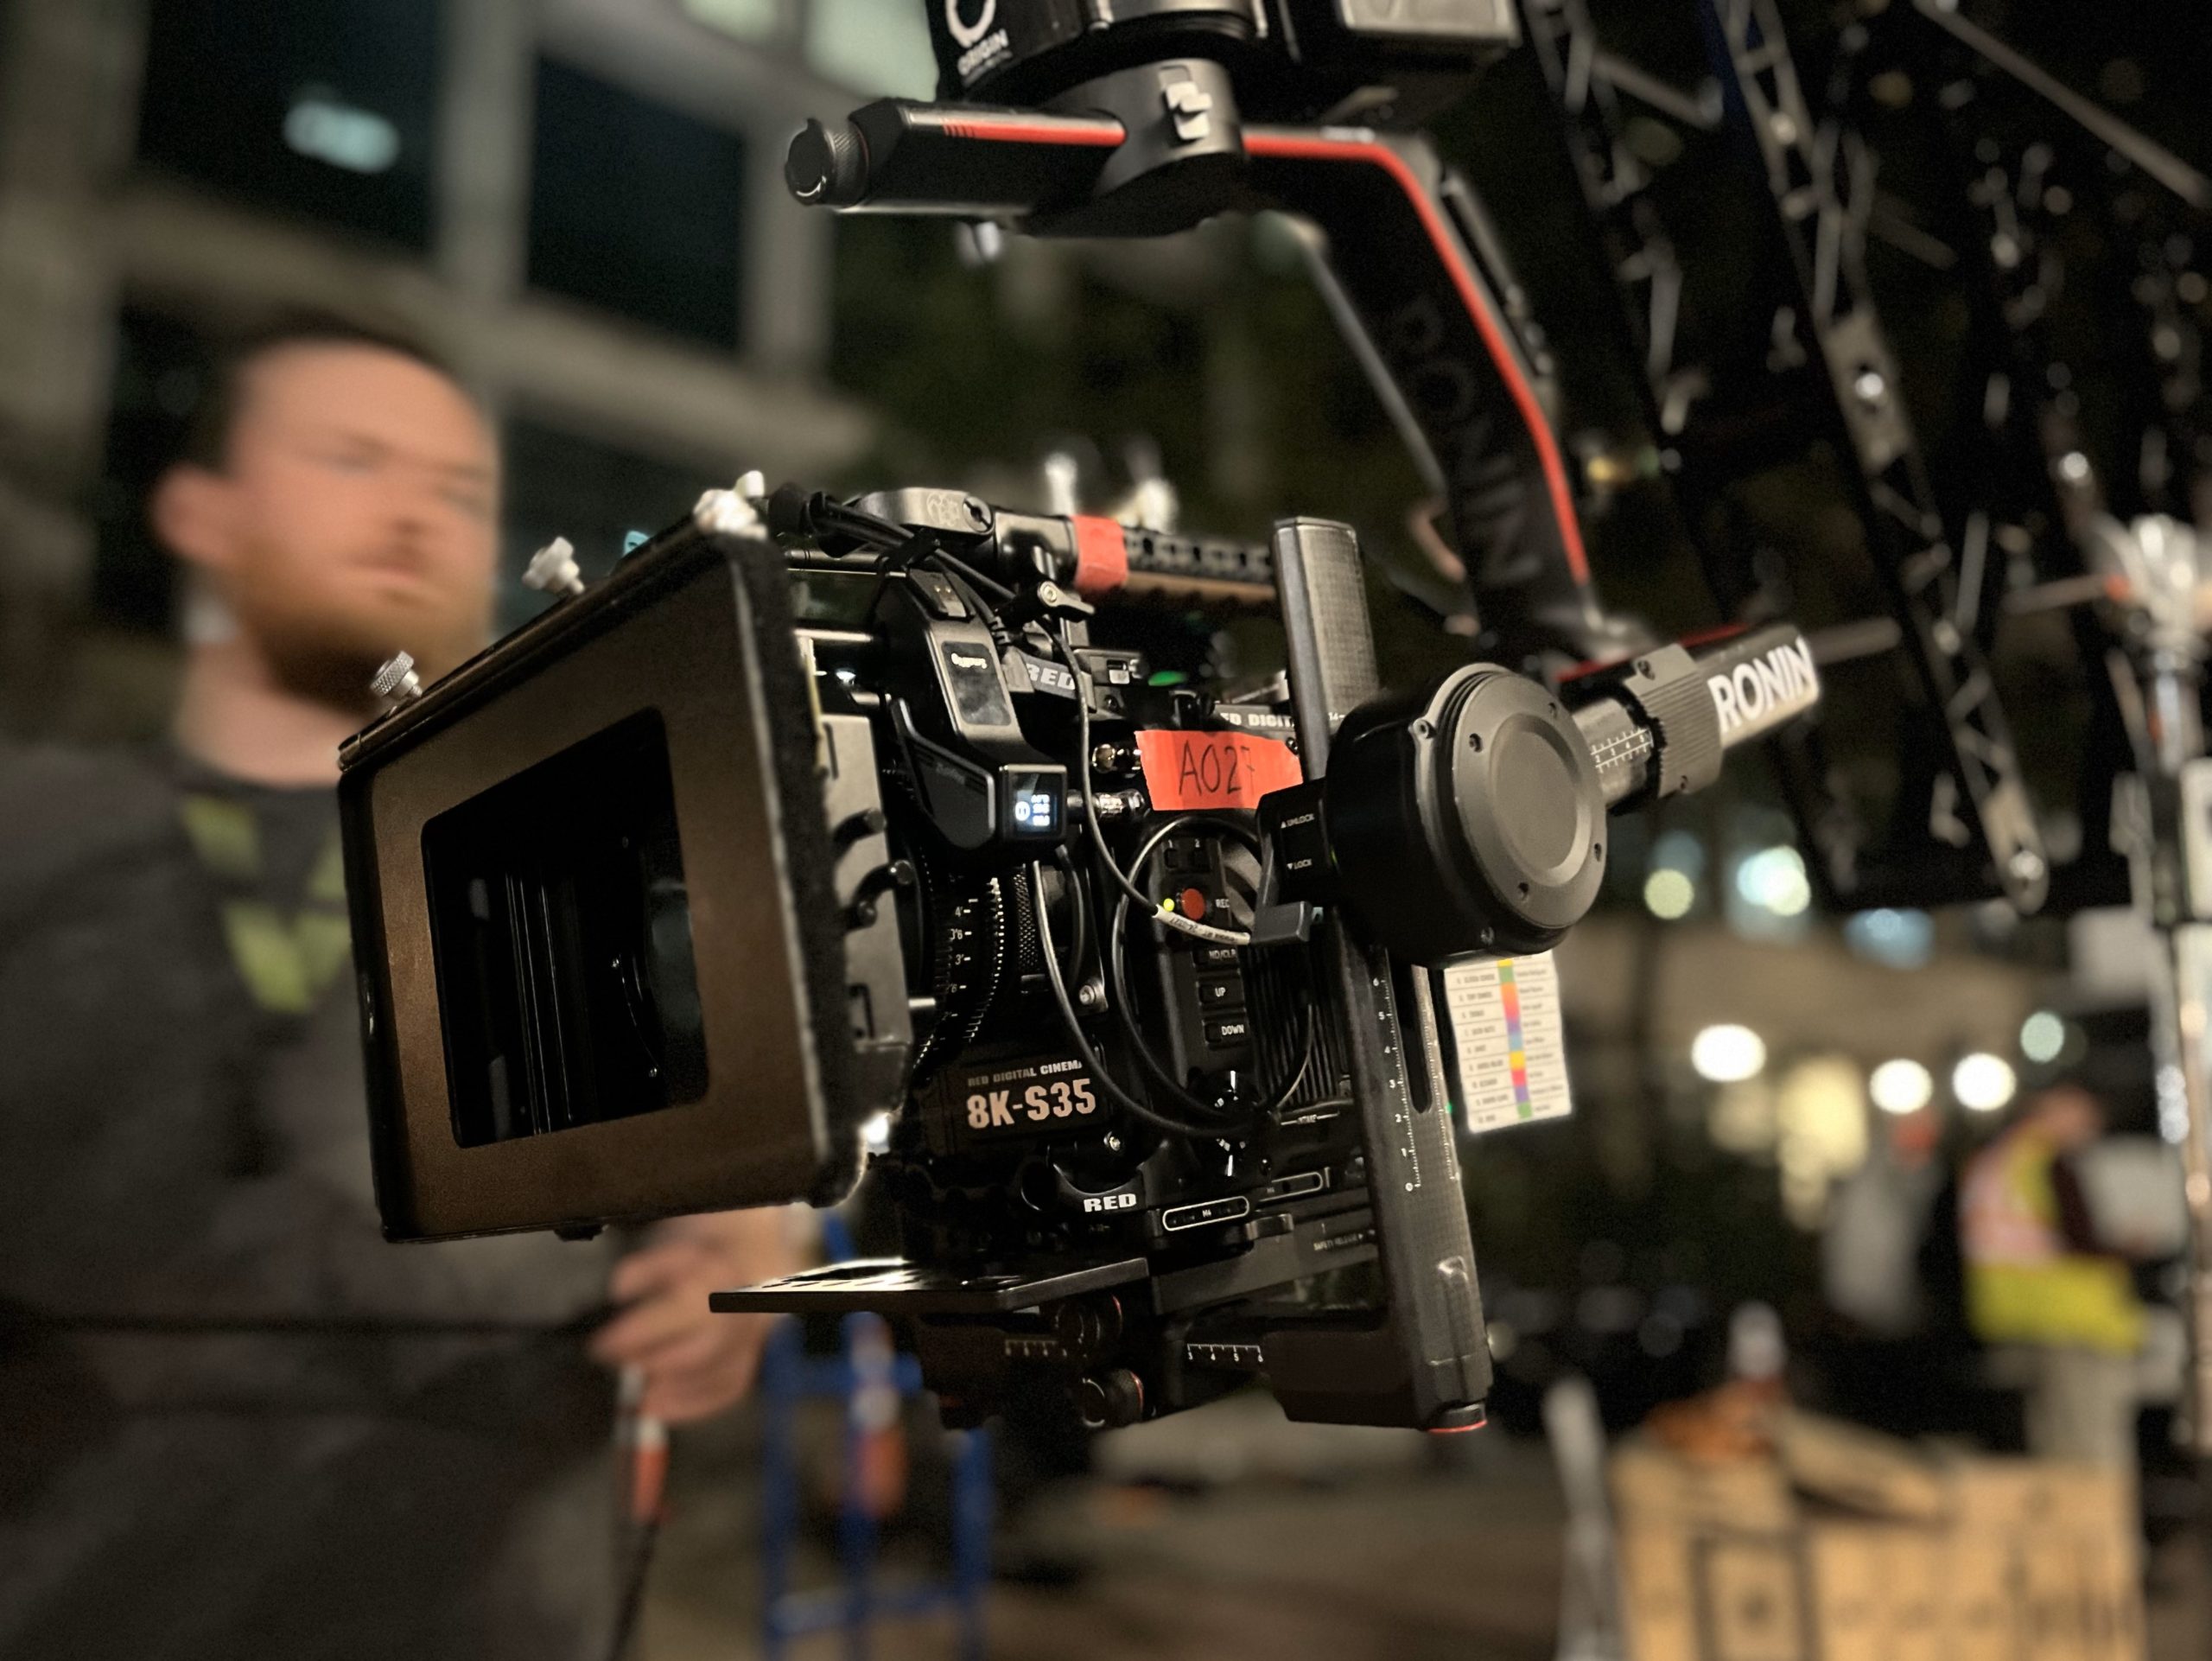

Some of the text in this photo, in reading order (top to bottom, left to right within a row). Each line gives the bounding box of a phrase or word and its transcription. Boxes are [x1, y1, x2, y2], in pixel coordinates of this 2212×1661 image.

[1026, 662, 1076, 690] RED
[1707, 635, 1819, 736] RONIN
[1249, 714, 1295, 727] DIGIT
[1215, 987, 1226, 997] UP
[1221, 1024, 1244, 1035] DOWN
[994, 1067, 1037, 1083] DIGITAL
[967, 1078, 1096, 1130] 8K-S35
[1084, 1193, 1137, 1212] RED
